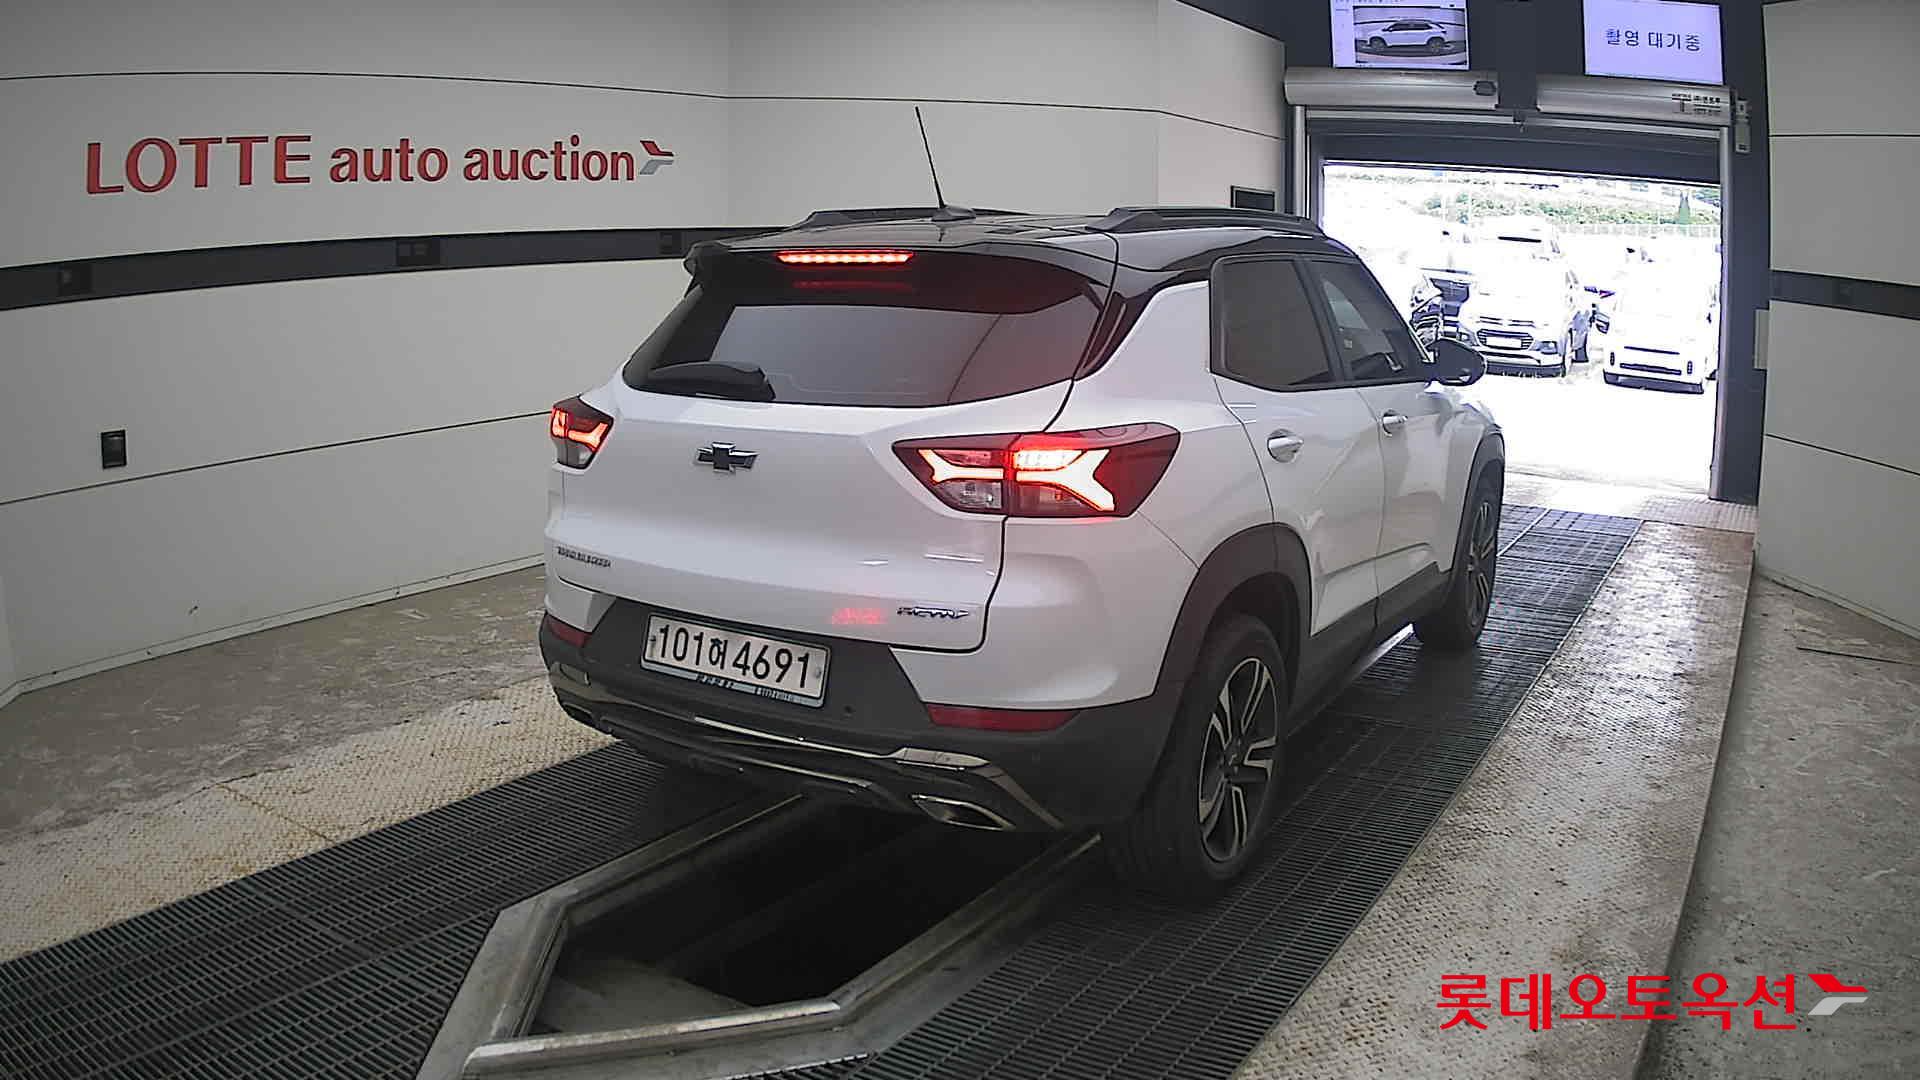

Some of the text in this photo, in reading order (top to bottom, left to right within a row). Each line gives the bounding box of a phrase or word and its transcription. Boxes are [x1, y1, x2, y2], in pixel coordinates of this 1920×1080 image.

[1647, 31, 1701, 52] 대기중
[86, 134, 635, 195] LOTTE auto auction
[659, 624, 810, 689] 101허4691
